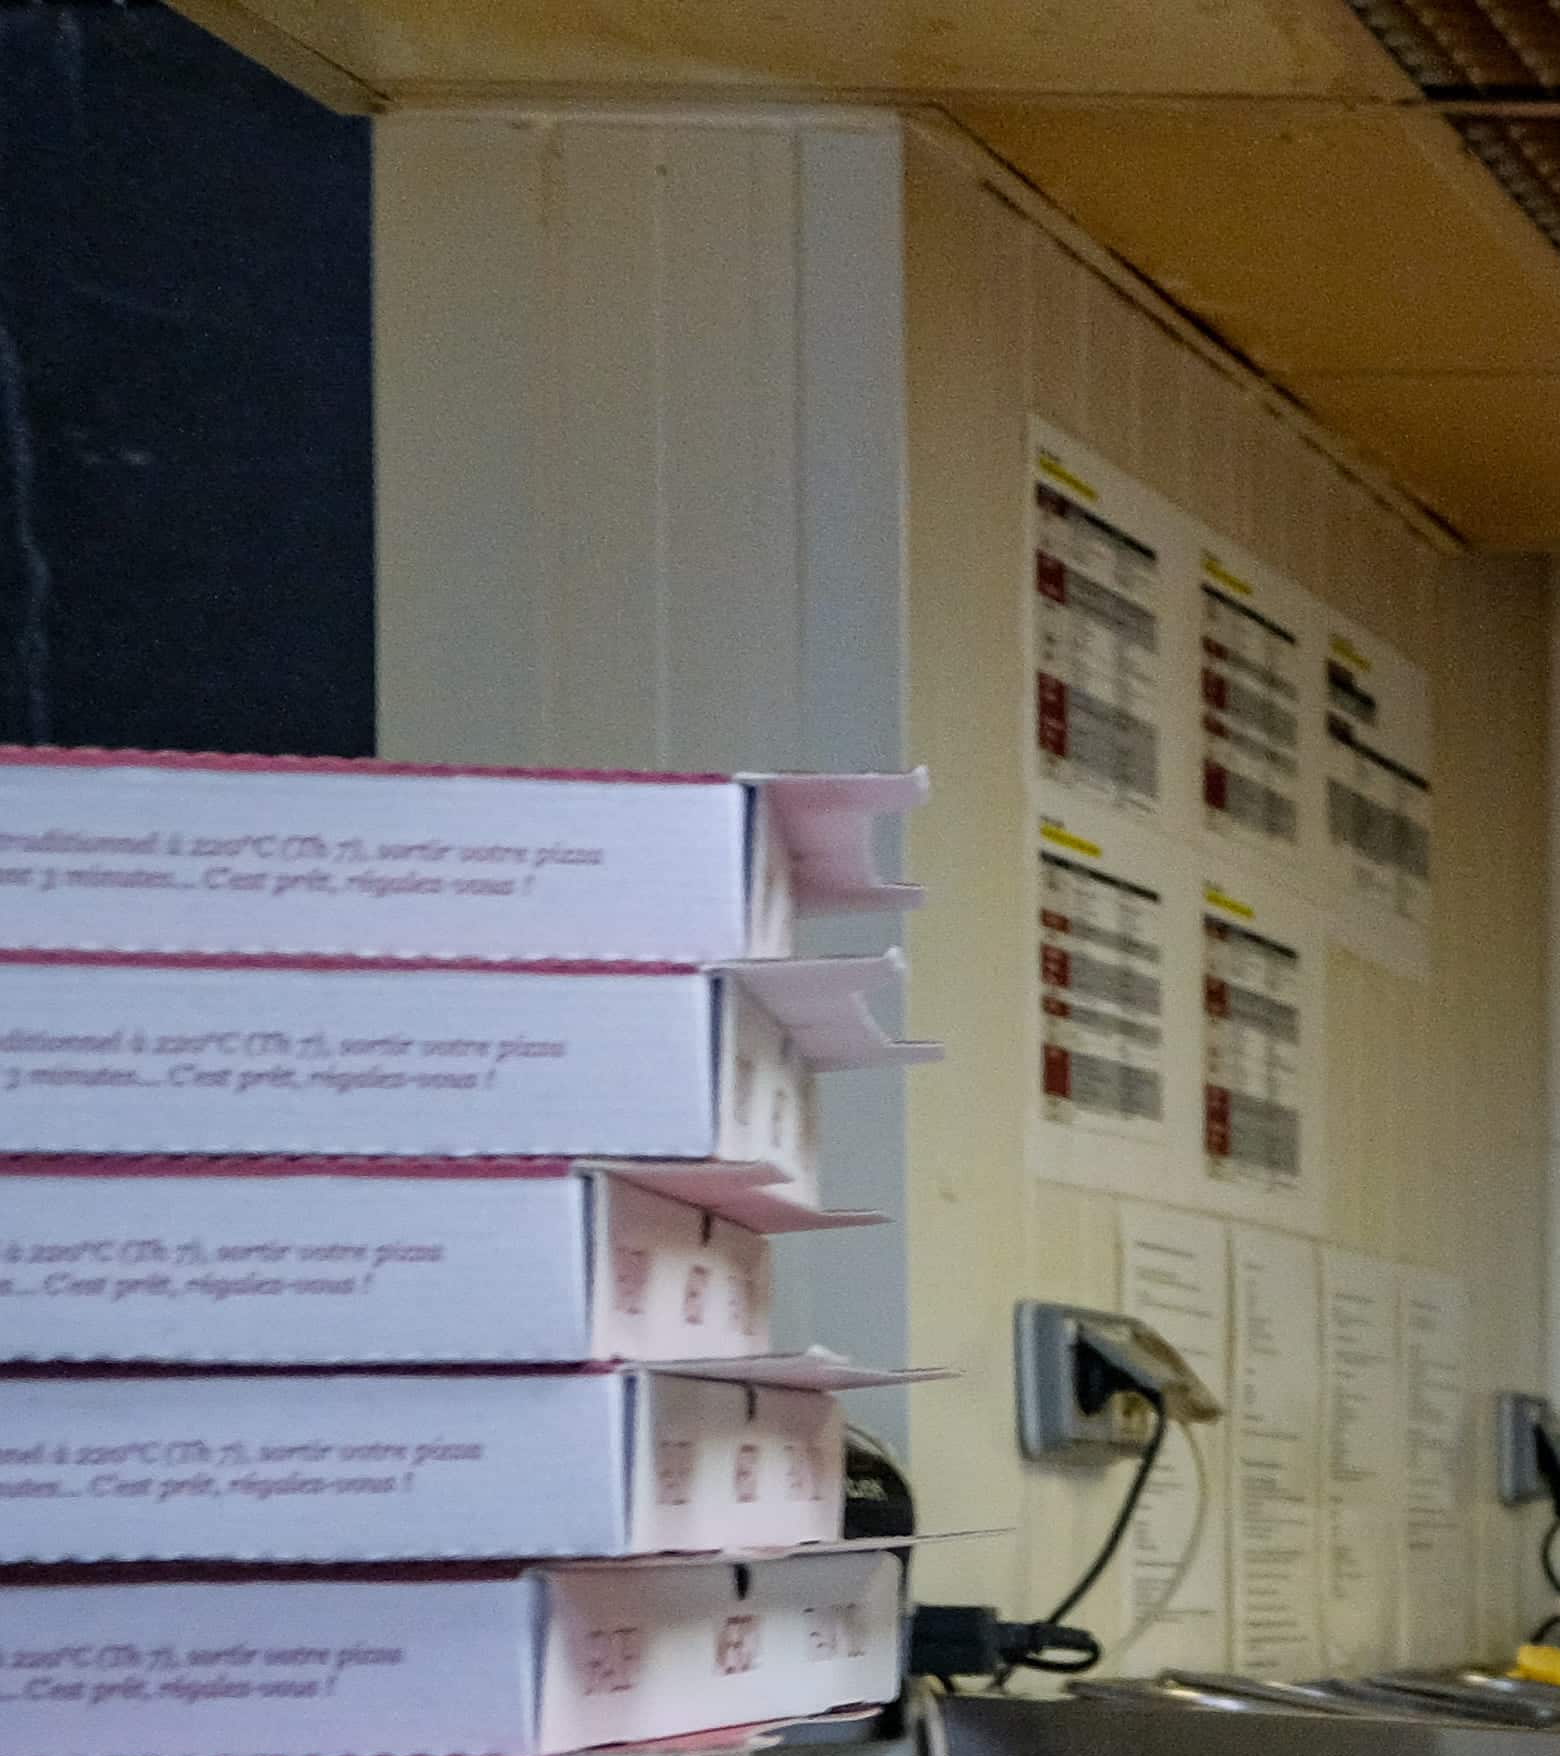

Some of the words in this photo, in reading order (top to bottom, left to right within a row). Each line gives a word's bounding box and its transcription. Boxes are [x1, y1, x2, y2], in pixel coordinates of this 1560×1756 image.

[376, 838, 453, 863] sortir
[458, 846, 528, 863] votre
[531, 843, 603, 868] pizza
[339, 1033, 414, 1058] sortir
[417, 1040, 490, 1057] votre
[493, 1034, 566, 1062] pizza
[216, 1240, 291, 1263] sortir
[297, 1245, 367, 1263] votre
[371, 1242, 444, 1267] pizza
[411, 1437, 484, 1467] pizza
[335, 1641, 404, 1671] pizza
